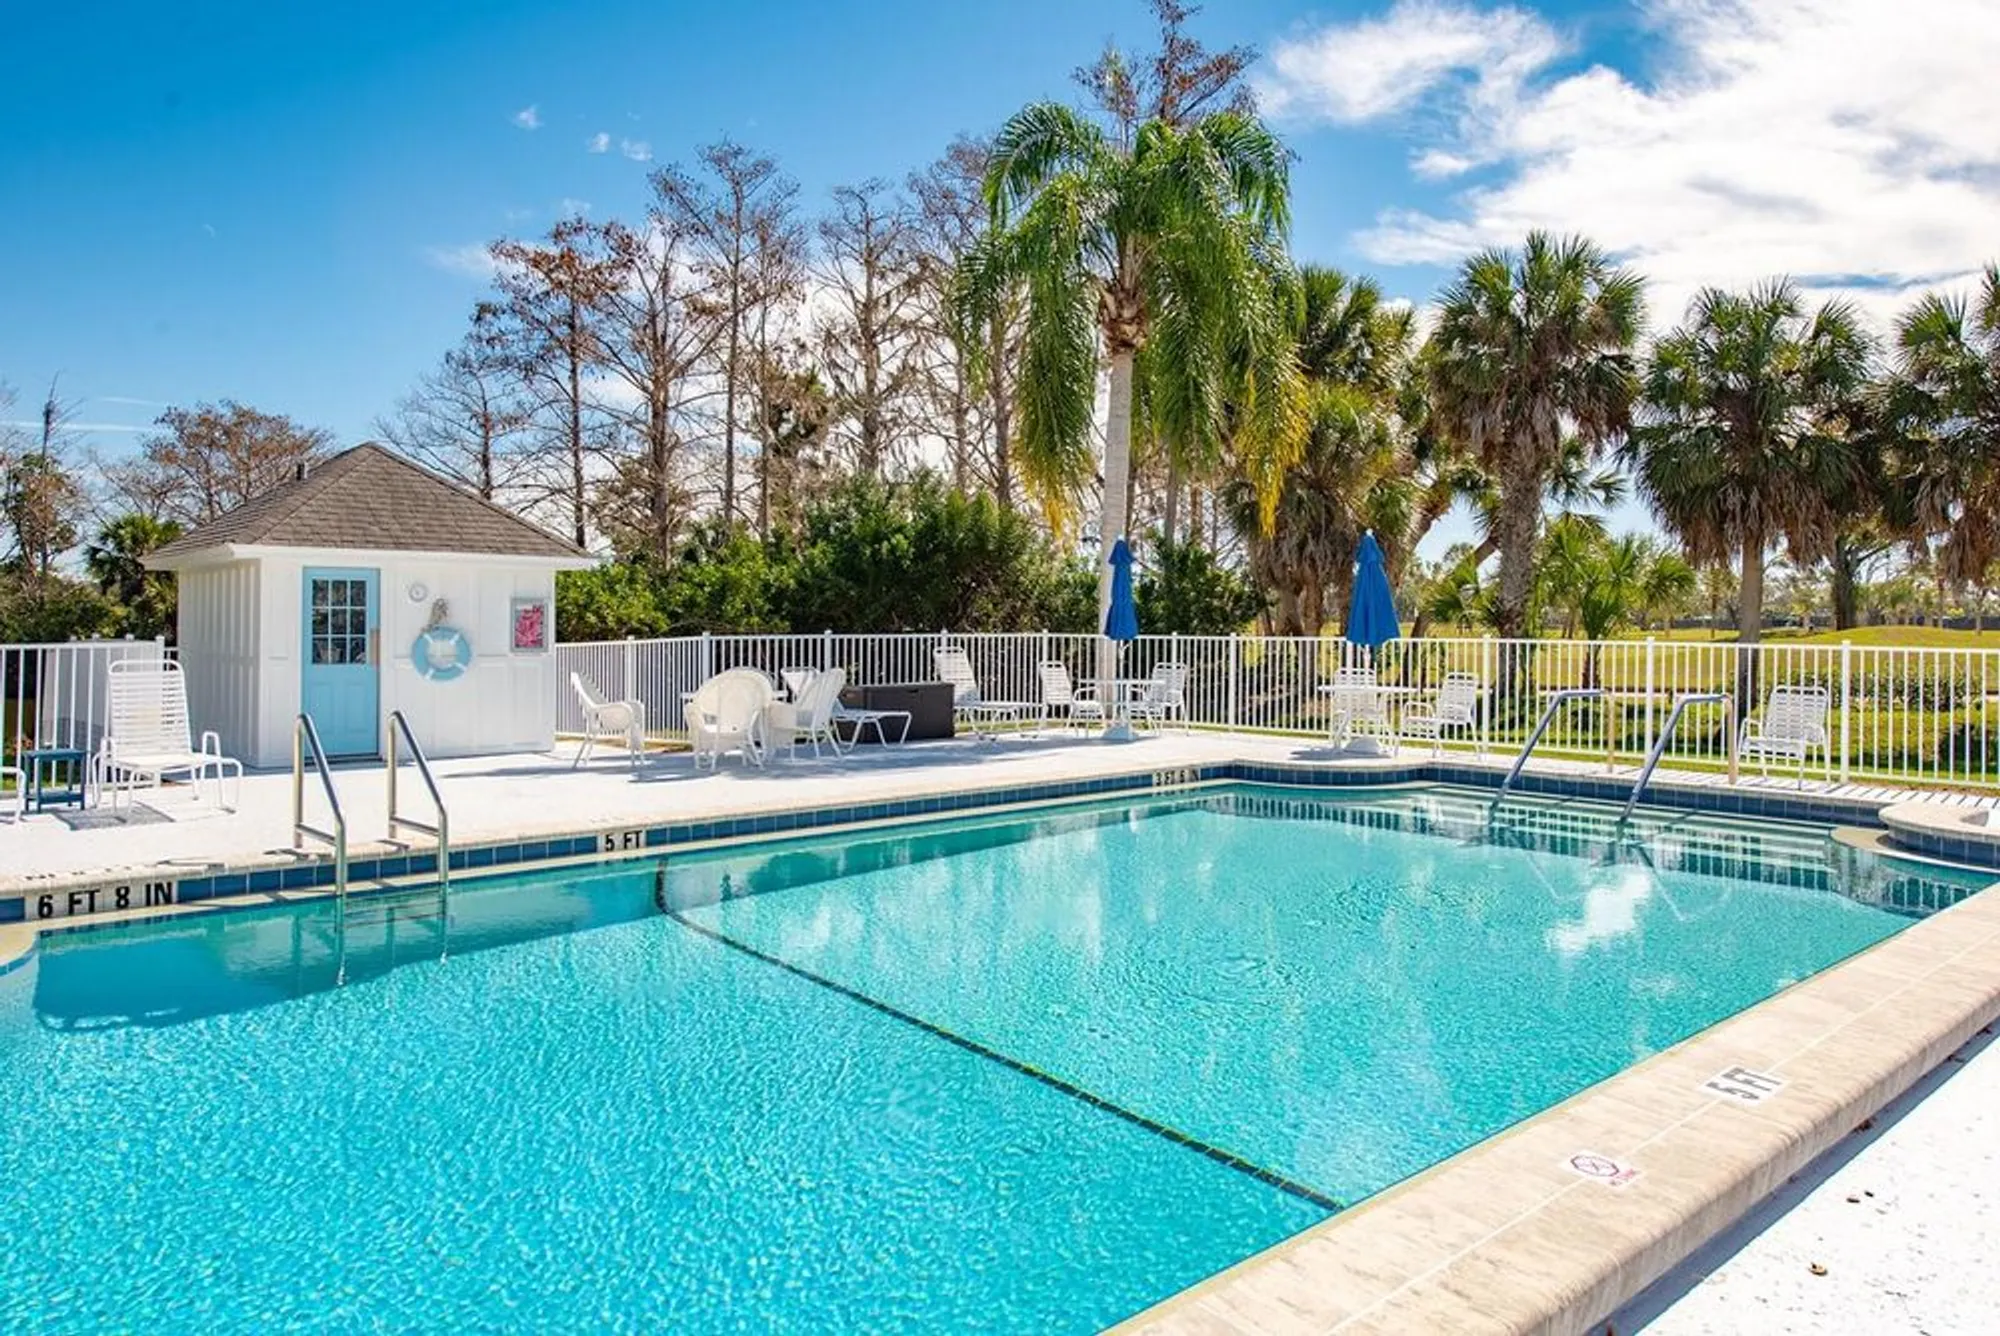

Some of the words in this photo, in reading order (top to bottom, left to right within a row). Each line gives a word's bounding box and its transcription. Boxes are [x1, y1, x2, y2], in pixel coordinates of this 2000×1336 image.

[605, 832, 615, 851] 5
[623, 830, 643, 849] FT
[38, 894, 54, 918] 6
[68, 889, 100, 915] FT
[115, 886, 130, 909] 8
[145, 882, 173, 906] IN
[1705, 1081, 1760, 1100] 5
[1721, 1067, 1783, 1092] FT
